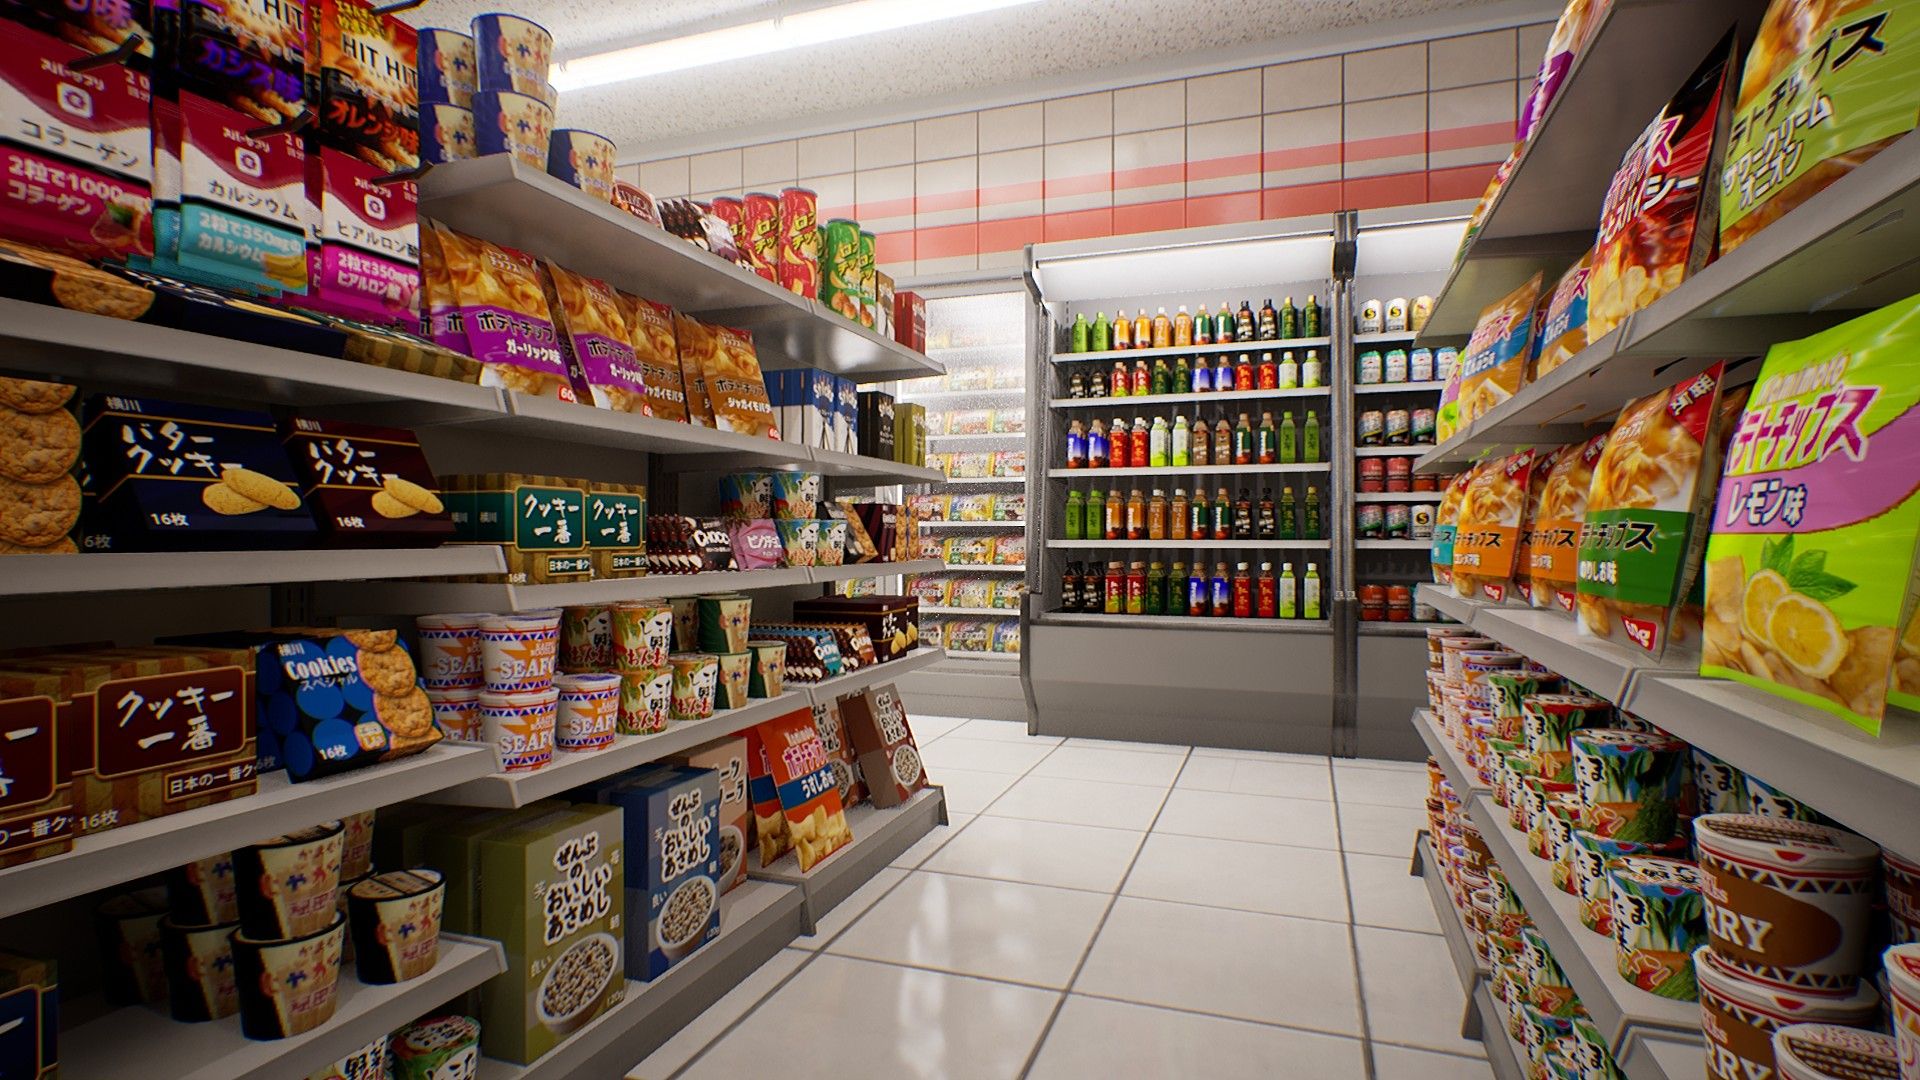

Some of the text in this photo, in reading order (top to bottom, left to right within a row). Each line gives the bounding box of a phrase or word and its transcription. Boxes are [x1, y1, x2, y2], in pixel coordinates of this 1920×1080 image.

[342, 32, 418, 90] HIT HIT
[20, 118, 139, 168] コラーゲン
[1722, 87, 1835, 197] サワークリーム
[1739, 139, 1805, 212] オニオン
[8, 178, 93, 216] コラーゲン
[208, 179, 298, 220] カルシウム
[198, 232, 263, 263] カルシウム
[506, 338, 562, 365] ガーリック味
[609, 363, 643, 386] ガーリック味
[106, 396, 142, 412] 横川
[122, 421, 214, 451] バター
[127, 444, 243, 477] クッキー
[309, 438, 376, 465] バター
[314, 459, 398, 487] クッキー
[524, 493, 580, 519] クッキー
[593, 499, 638, 520] クッキー
[1726, 478, 1808, 527] レモン味
[150, 511, 190, 527] 16枚
[336, 516, 366, 529] 16枚
[533, 518, 572, 545] 一番
[600, 521, 632, 544] 一番
[84, 534, 112, 550] 6枚
[278, 642, 305, 656] 横川
[284, 654, 357, 681] Cookies
[301, 674, 358, 691] スペシャル
[117, 686, 234, 728] クッキー
[137, 714, 218, 751] 一番
[319, 744, 348, 761] 16枚
[79, 808, 119, 829] 16枚
[680, 813, 691, 828] の
[662, 816, 711, 856] おいしい
[553, 831, 599, 871] ぜんぶ
[661, 840, 710, 883] あさめし
[568, 862, 584, 881] の
[546, 864, 612, 916] おいしい
[545, 889, 611, 946] あさめし
